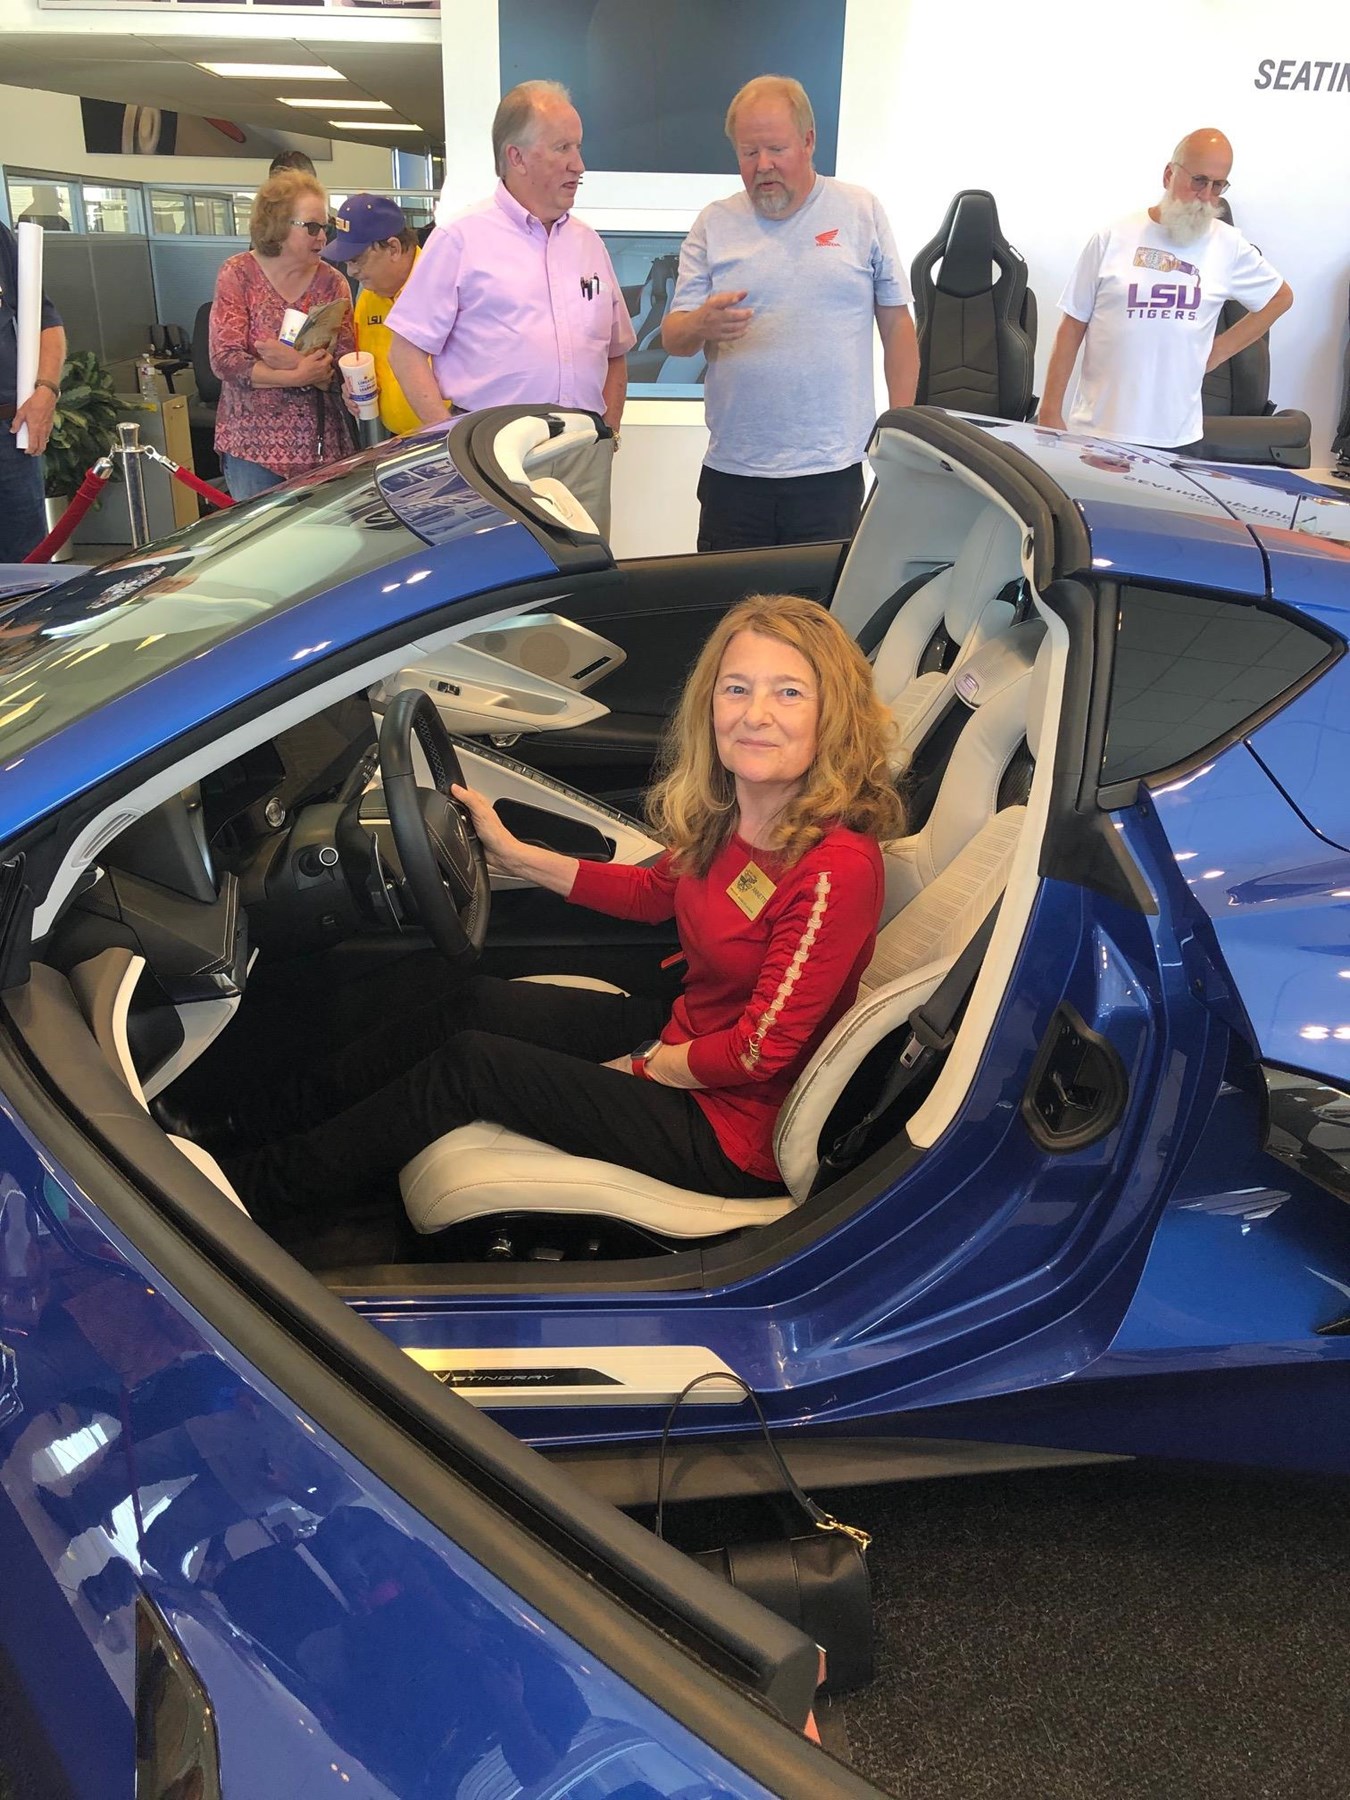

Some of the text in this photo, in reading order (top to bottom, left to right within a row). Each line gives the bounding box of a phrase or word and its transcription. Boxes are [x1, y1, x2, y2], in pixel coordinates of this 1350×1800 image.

[336, 216, 350, 232] SU
[1127, 283, 1201, 310] LSU
[367, 315, 382, 325] LSU
[1126, 309, 1197, 321] TIGERS
[451, 1374, 555, 1382] STINGRAY
